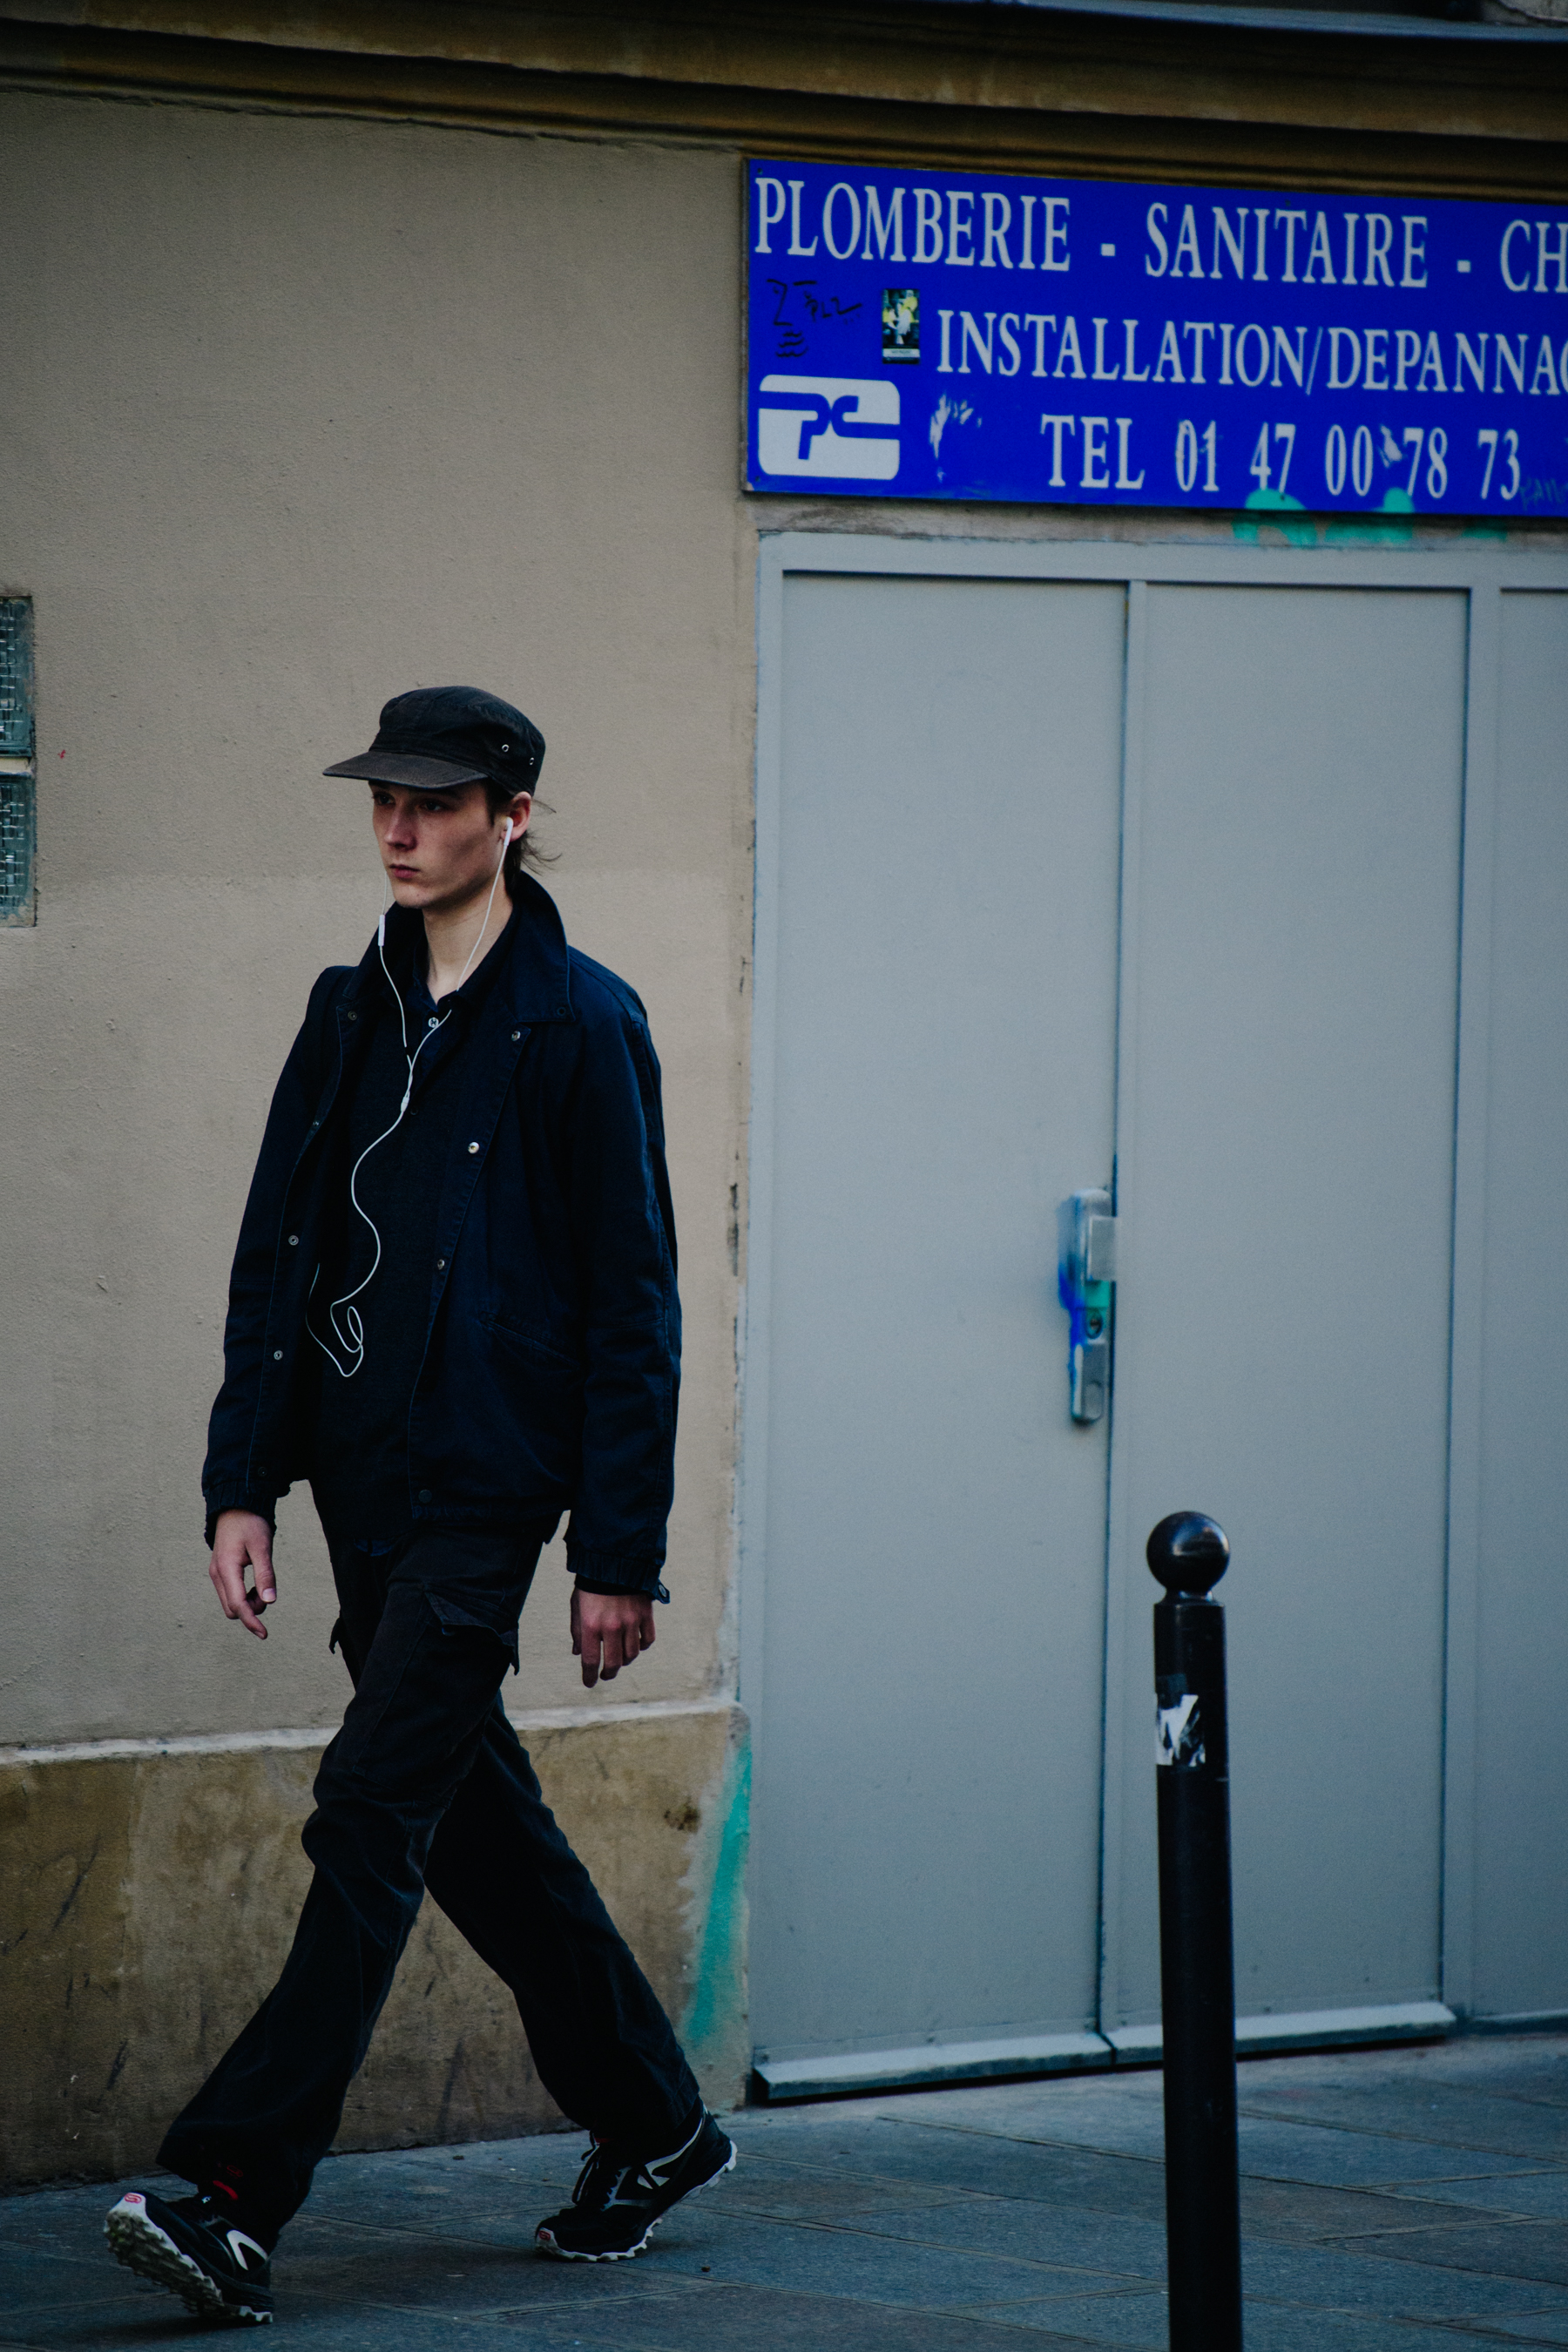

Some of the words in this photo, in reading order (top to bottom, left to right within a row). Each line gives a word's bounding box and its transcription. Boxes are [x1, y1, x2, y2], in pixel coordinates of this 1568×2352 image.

[754, 178, 1071, 272] PLOMBERIE
[1145, 202, 1428, 288] SANITAIRE
[1500, 220, 1568, 293] CH
[936, 309, 1568, 396] INSTALLATION/DEPANNA
[1040, 414, 1146, 490] TEL
[1175, 419, 1220, 493] 01
[1250, 422, 1296, 494] 47
[1325, 424, 1374, 497] 00
[1403, 427, 1448, 499] 78
[1478, 429, 1521, 500] 73
